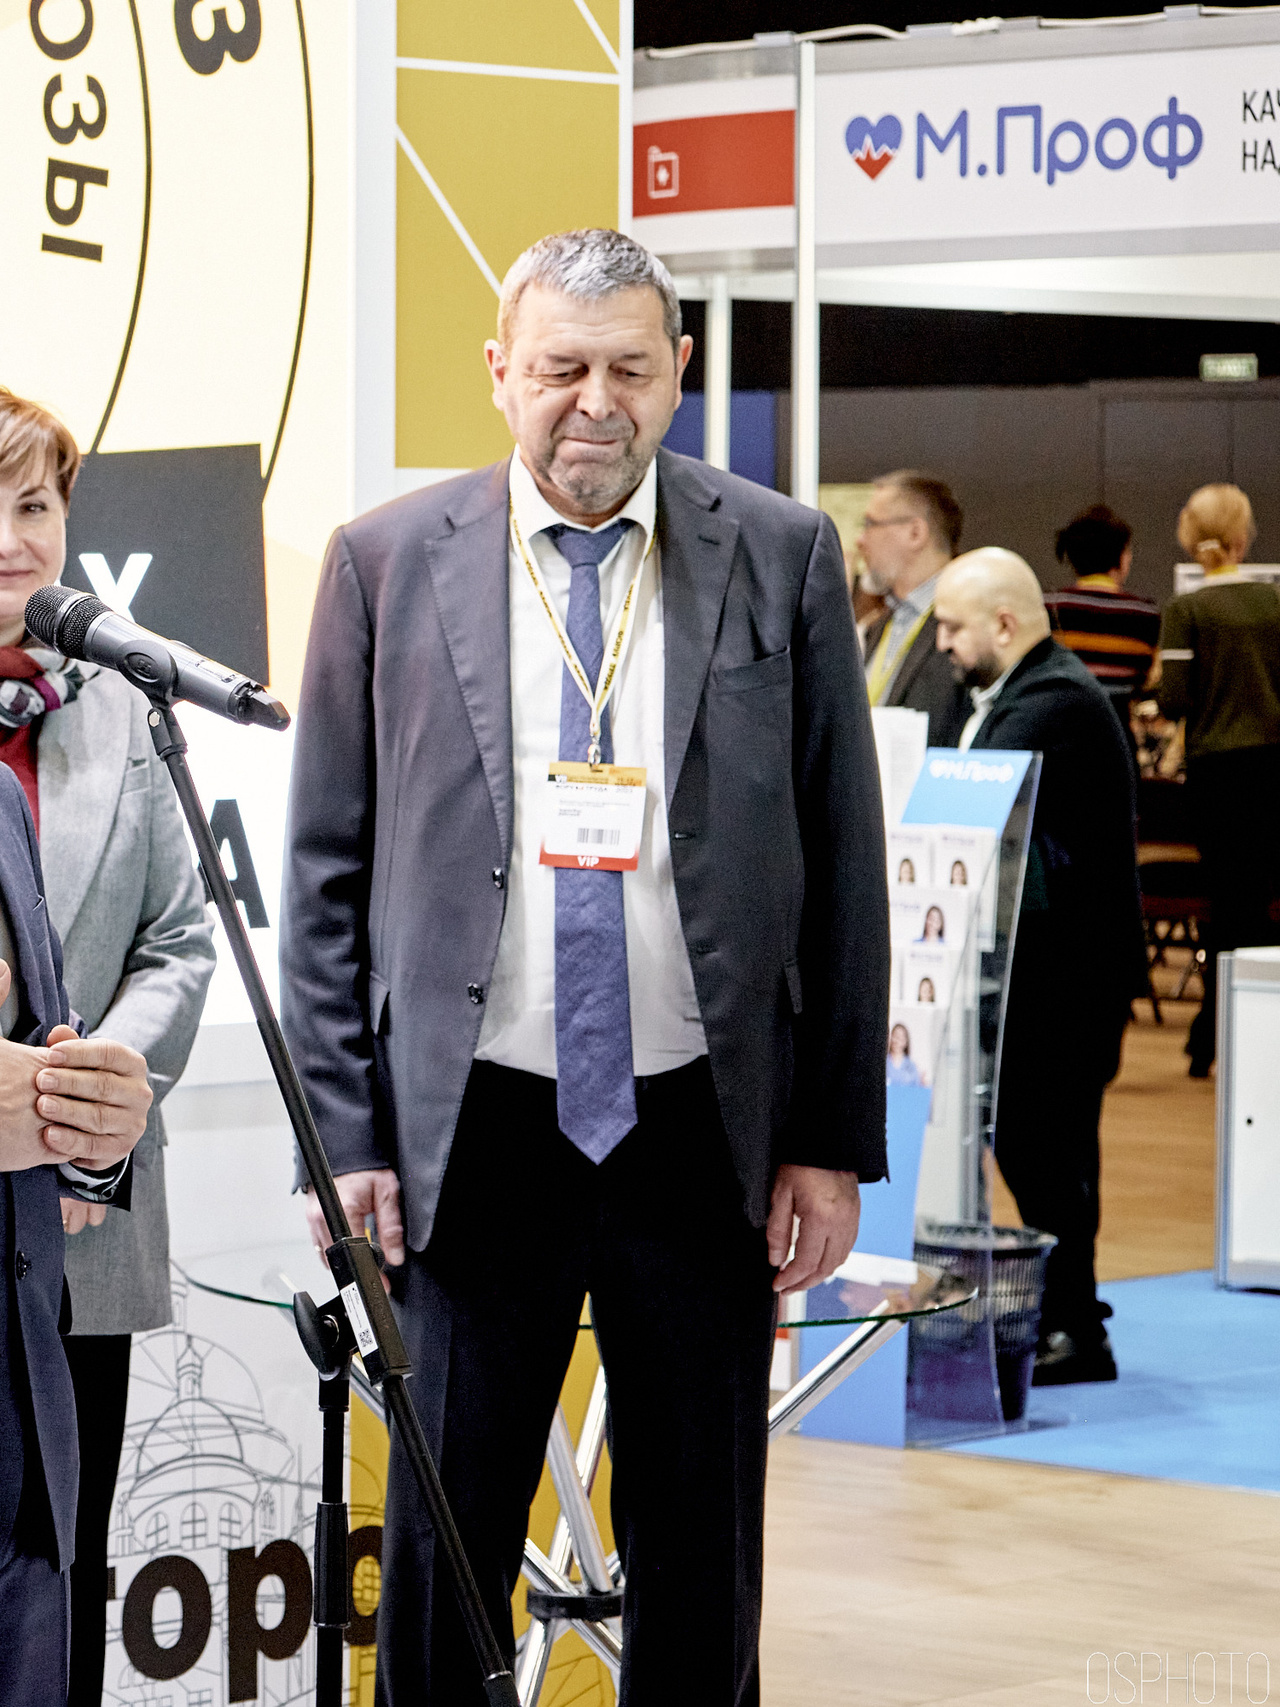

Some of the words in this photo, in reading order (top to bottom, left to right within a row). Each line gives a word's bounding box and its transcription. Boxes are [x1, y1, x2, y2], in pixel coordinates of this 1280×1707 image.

[1242, 88, 1280, 123] КА
[1242, 138, 1280, 173] НА
[577, 855, 600, 868] VIP
